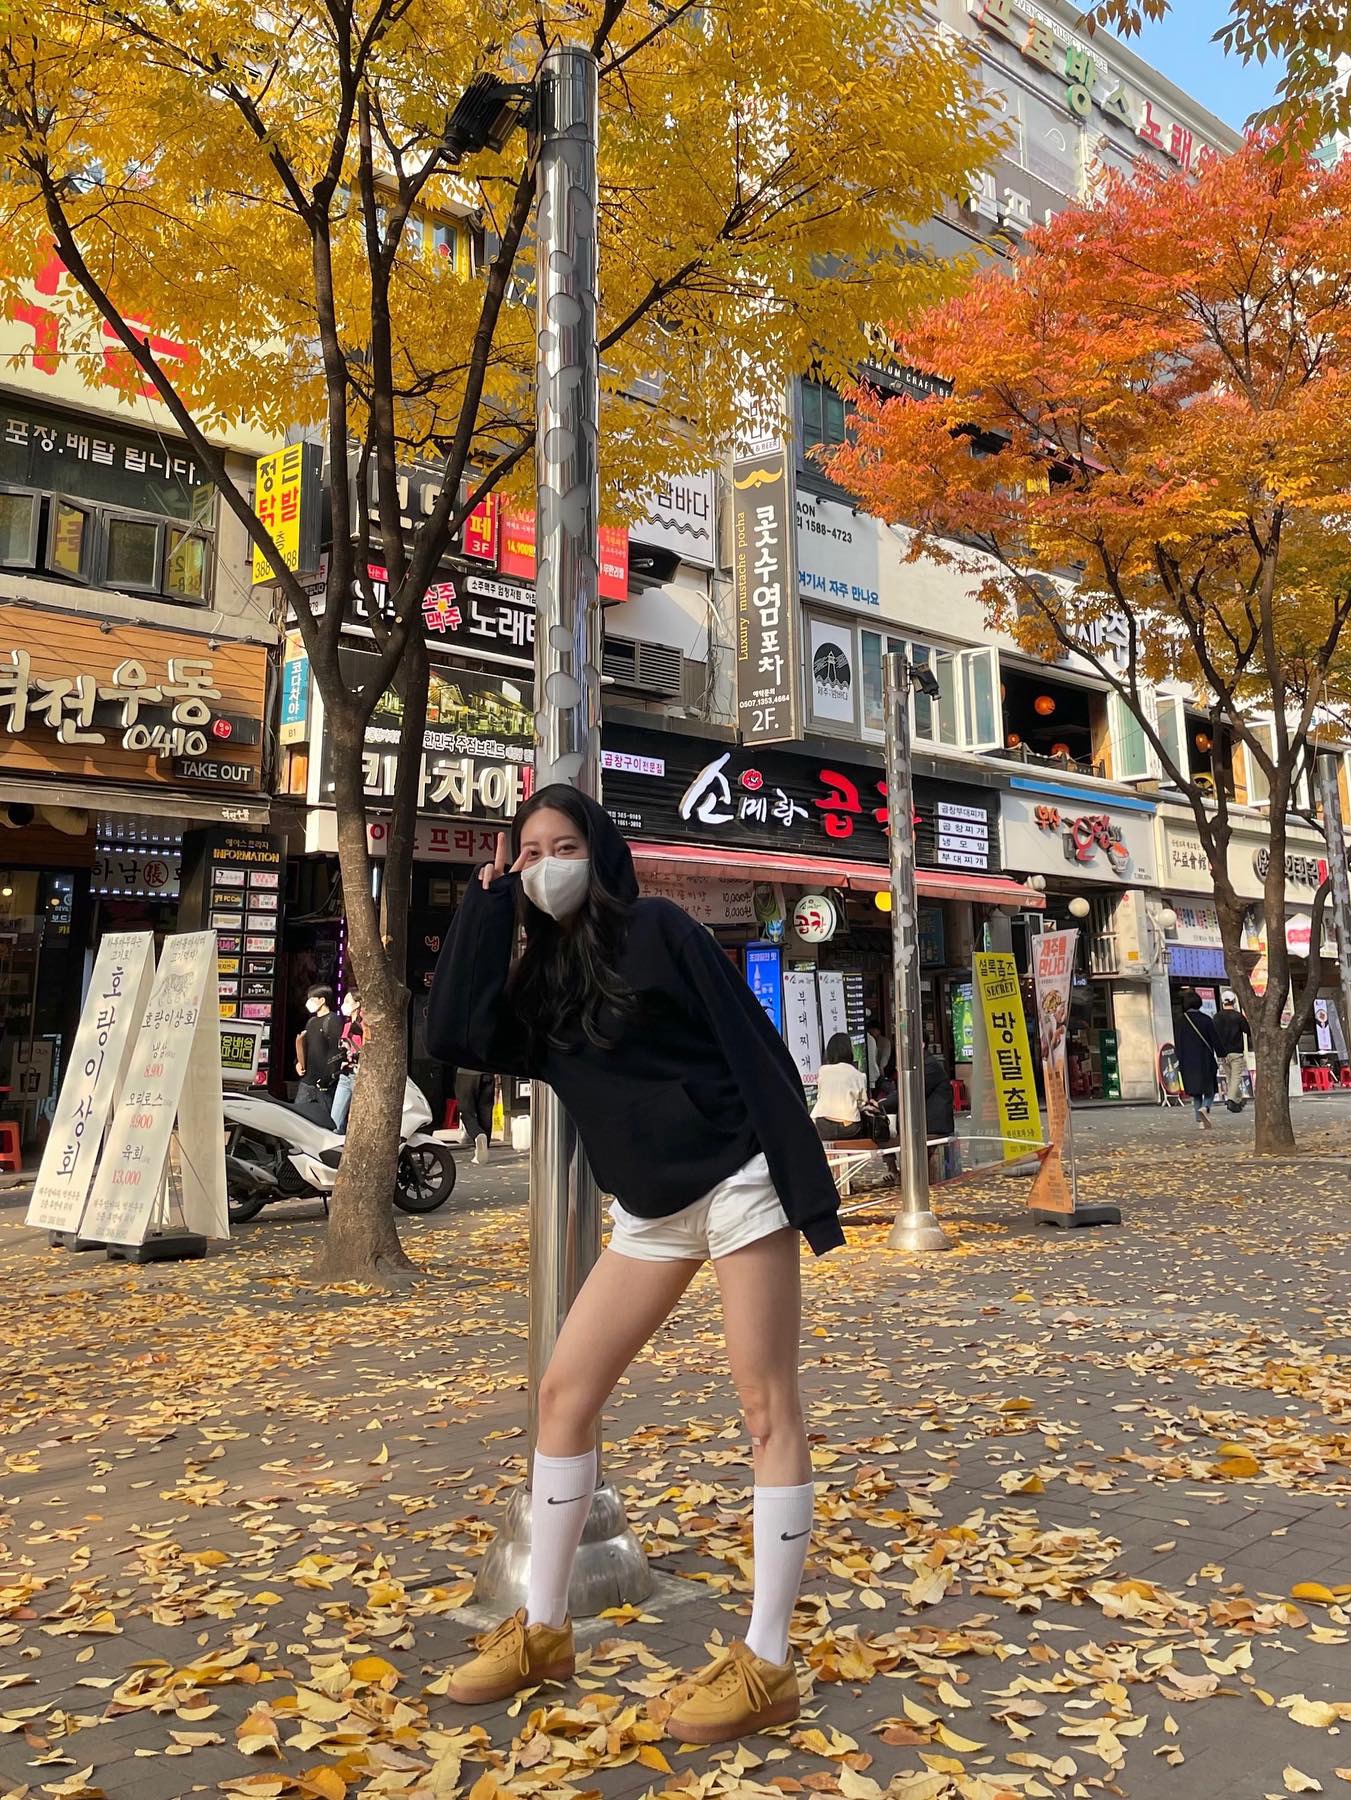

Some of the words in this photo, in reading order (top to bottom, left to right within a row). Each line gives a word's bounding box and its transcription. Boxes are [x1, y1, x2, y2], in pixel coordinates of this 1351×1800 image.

[737, 511, 747, 550] pocha
[806, 519, 853, 544] 1588-4723
[471, 540, 490, 554] 3F
[472, 579, 496, 595] 소주맥주
[737, 552, 748, 612] mustache
[829, 580, 849, 598] 자주
[851, 585, 880, 606] 만나요
[752, 504, 784, 686] 콧수염포차
[738, 616, 750, 663] Luxury
[122, 724, 208, 758] 0410
[456, 735, 506, 759] 주점브랜드
[181, 760, 218, 778] TAKE
[220, 764, 251, 783] OUT
[213, 848, 280, 863] INFORMATION
[986, 981, 1014, 997] SECRET
[141, 1009, 198, 1030] 호랑이상회
[57, 965, 124, 1185] 호랑이상회
[991, 1011, 1030, 1122] 방탈출
